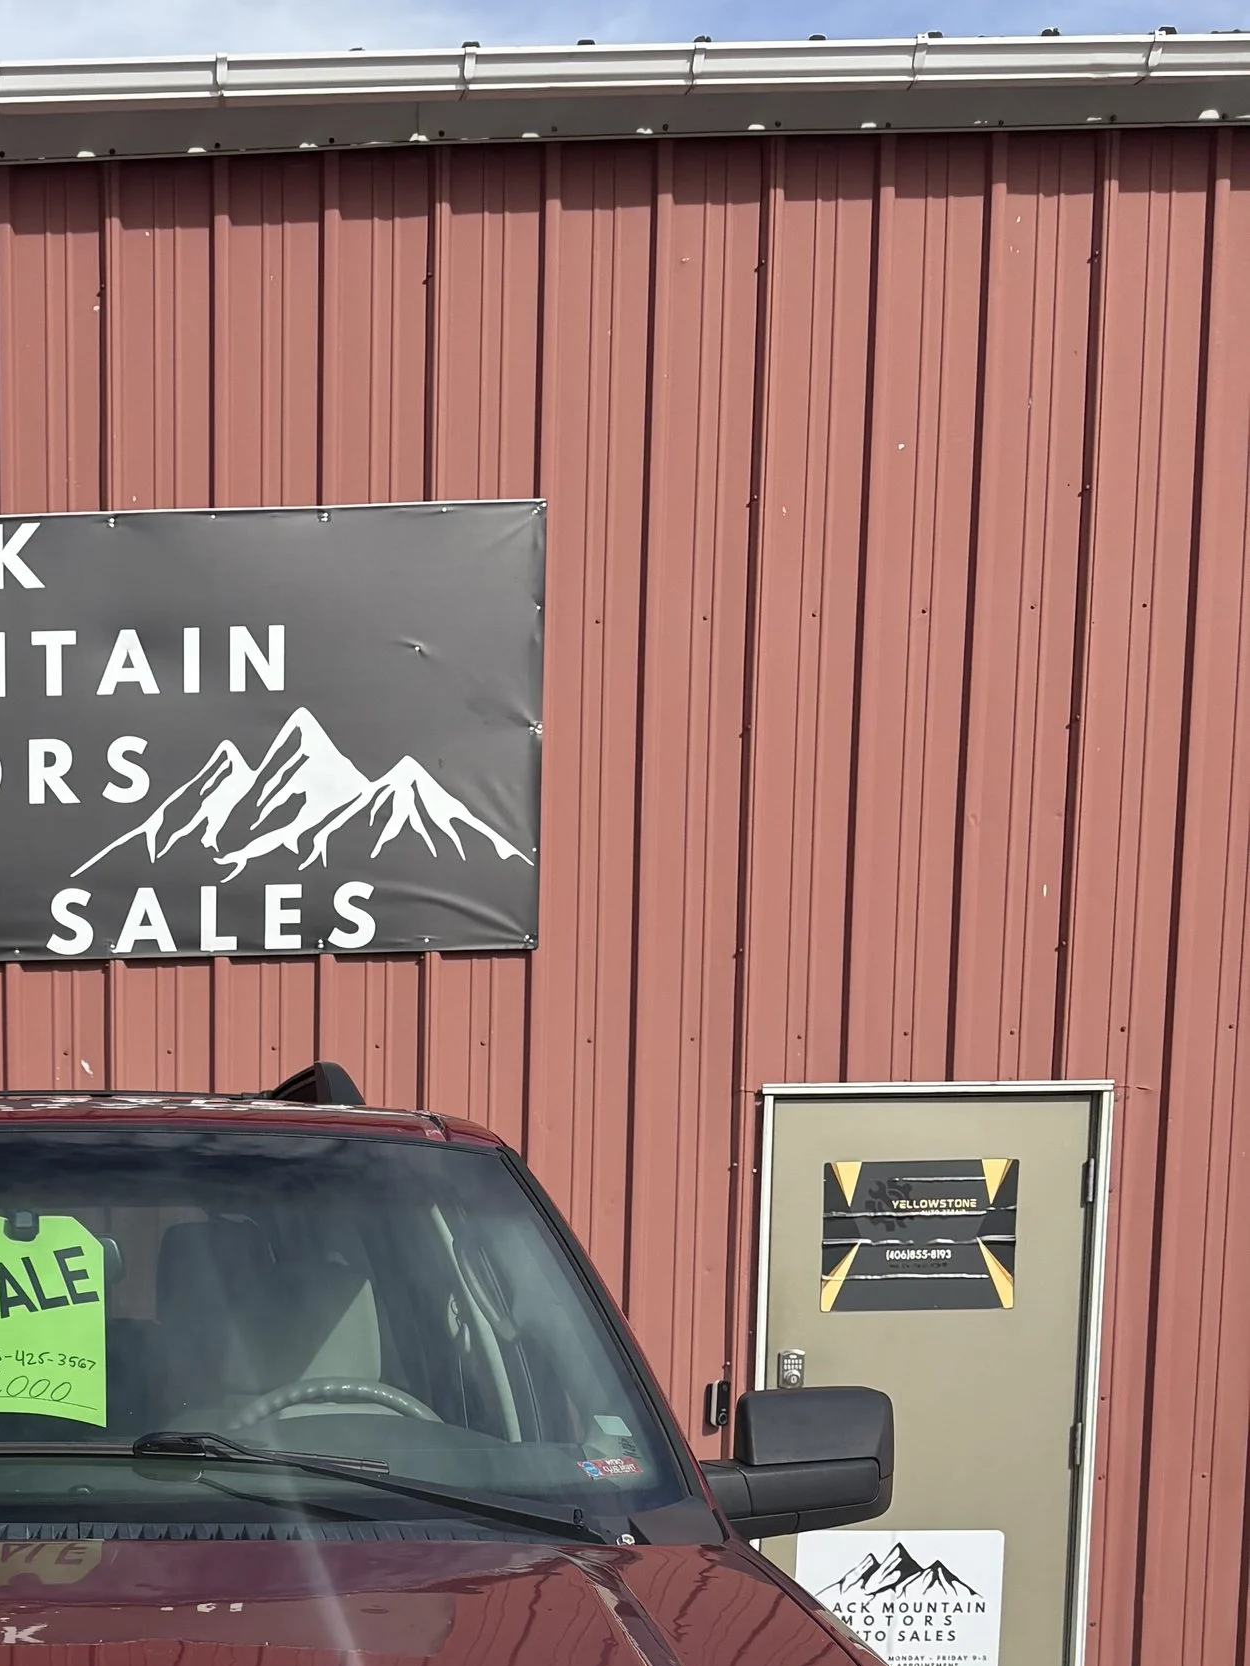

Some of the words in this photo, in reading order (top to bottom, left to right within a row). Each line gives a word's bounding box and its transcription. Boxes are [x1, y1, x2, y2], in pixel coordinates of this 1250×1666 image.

[46, 881, 377, 953] SALES
[892, 1199, 977, 1209] YELLOWSTONE
[886, 1250, 952, 1260] (406)855-8193
[832, 1602, 871, 1613] ACK
[882, 1602, 986, 1613] MOUNTAIN
[841, 1615, 952, 1626] MOTORS
[898, 1630, 956, 1642] SALES
